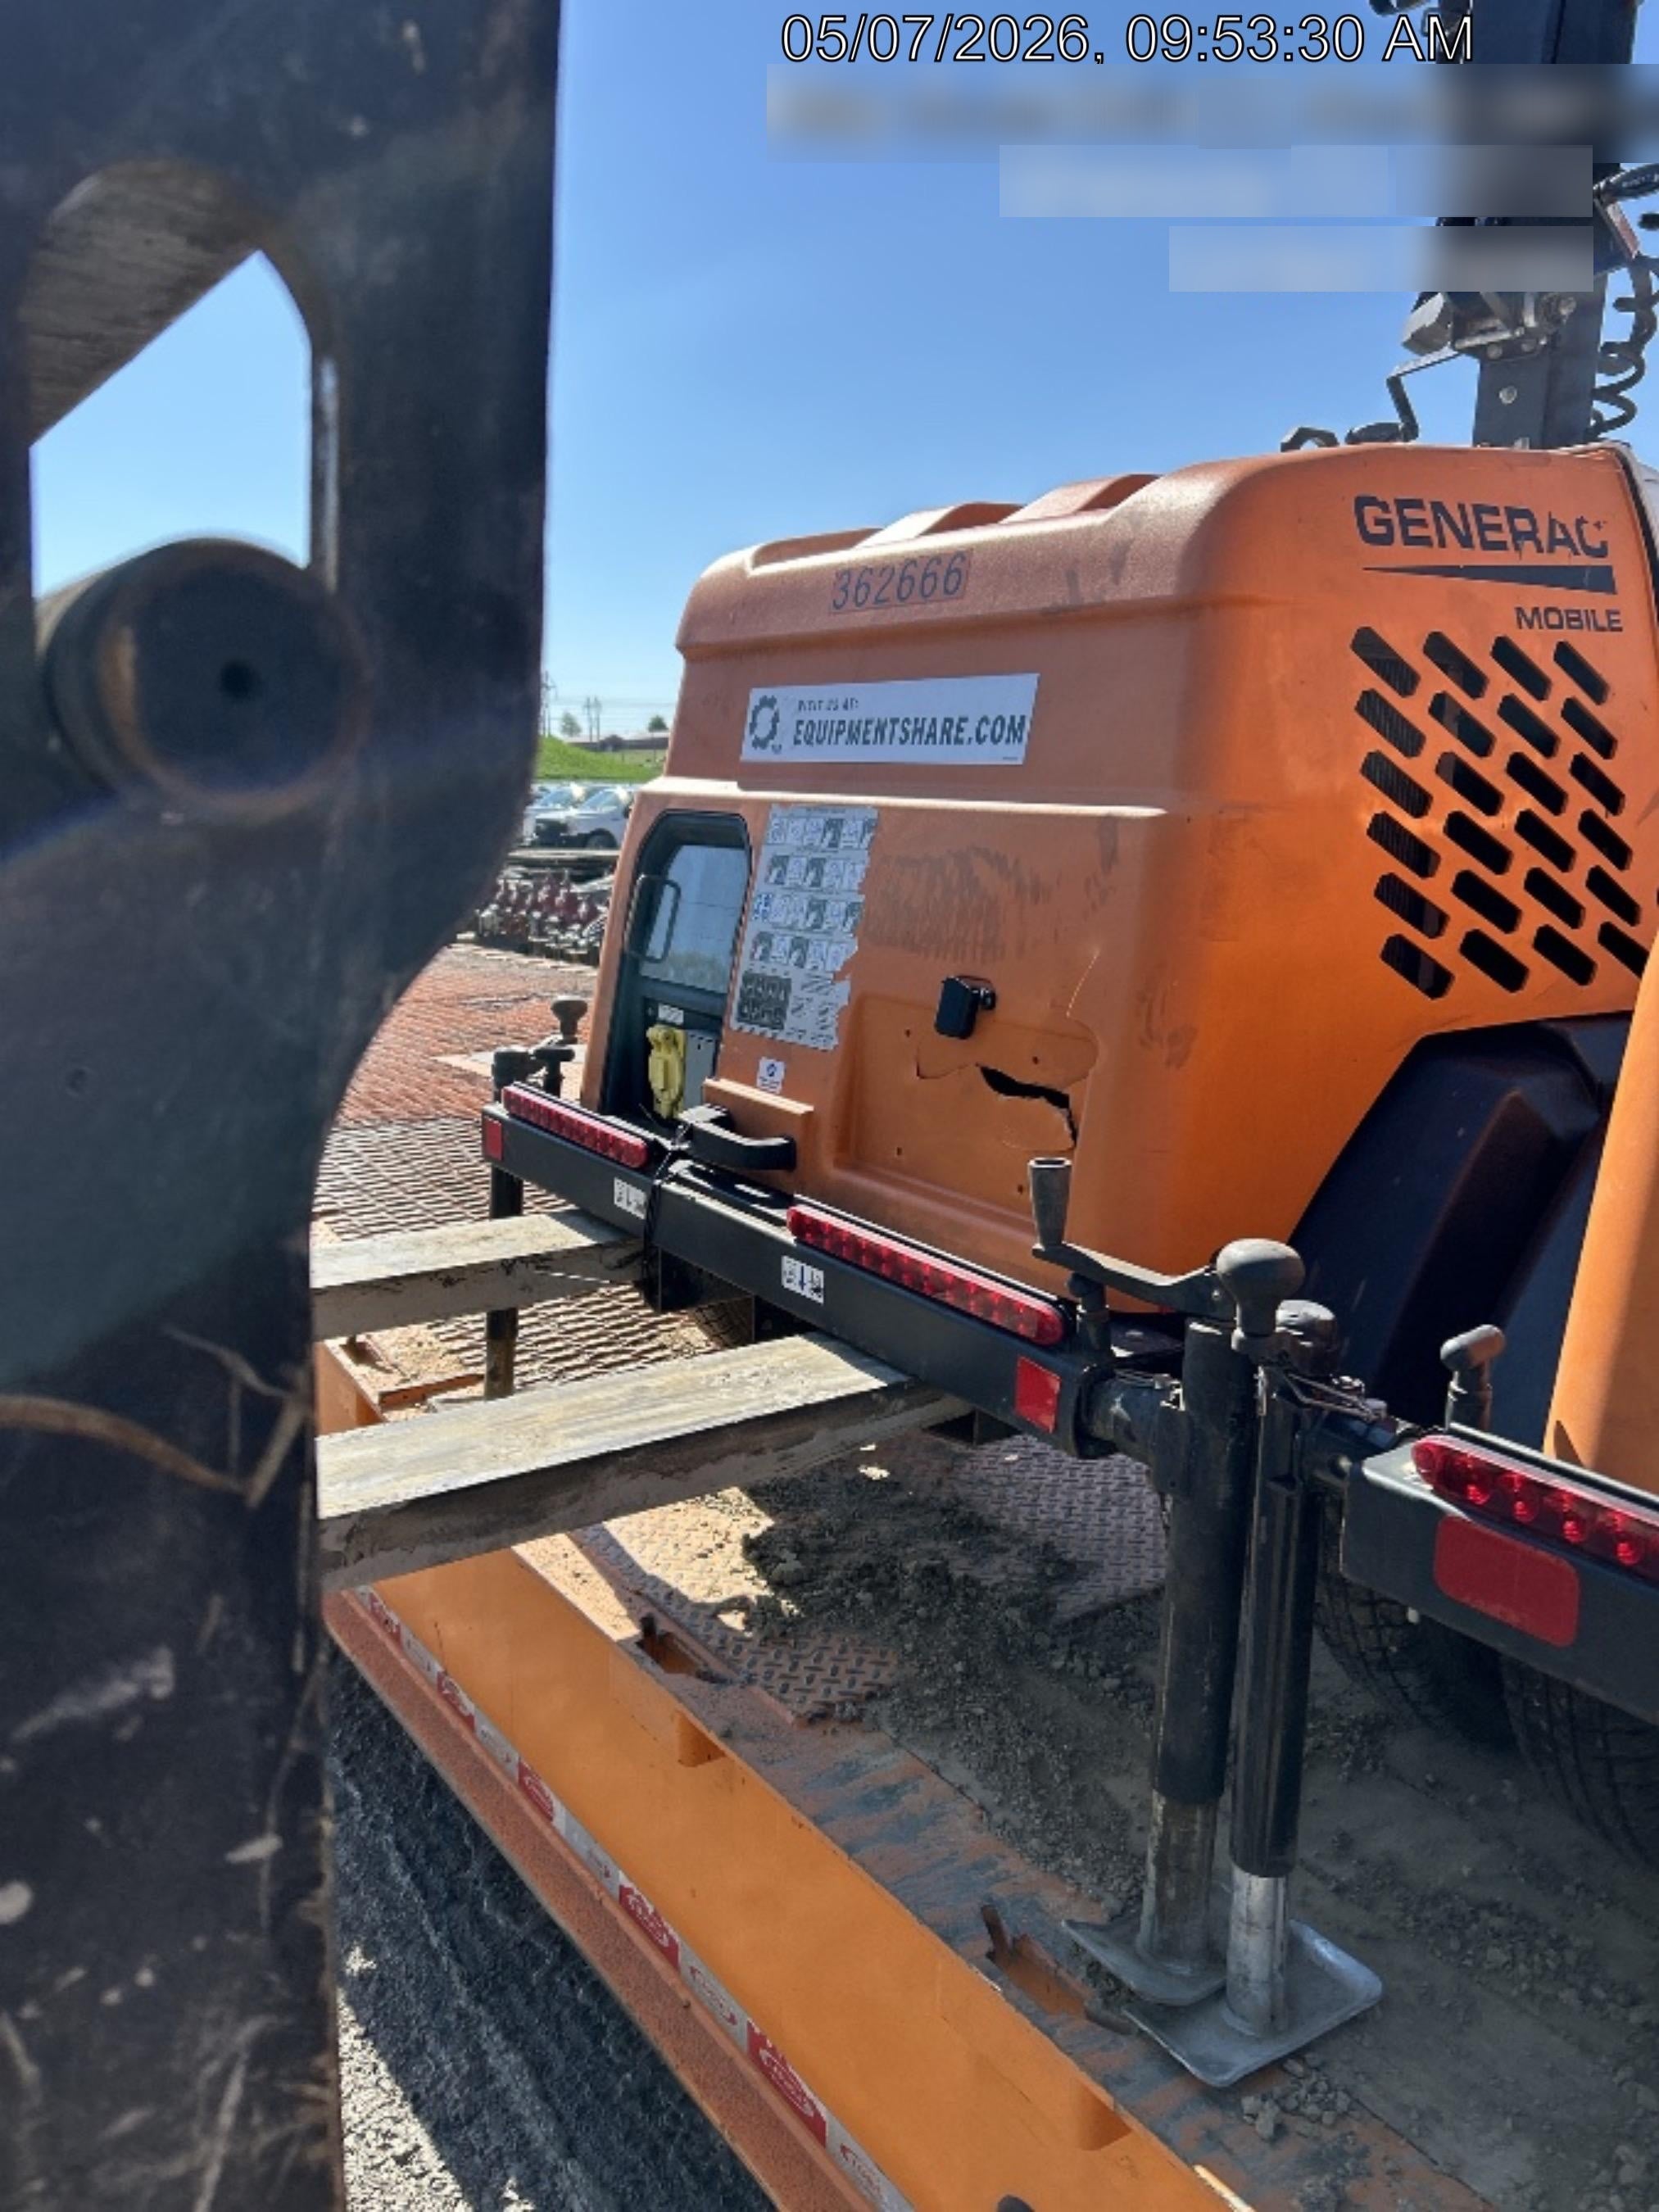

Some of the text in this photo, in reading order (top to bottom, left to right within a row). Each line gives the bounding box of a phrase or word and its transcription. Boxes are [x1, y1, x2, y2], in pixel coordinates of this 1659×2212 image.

[1354, 494, 1609, 559] GENERAC
[832, 552, 968, 610] 362666
[1515, 607, 1623, 632] MOBILE
[792, 714, 1027, 747] EQUIPMENTSHARE.COM
